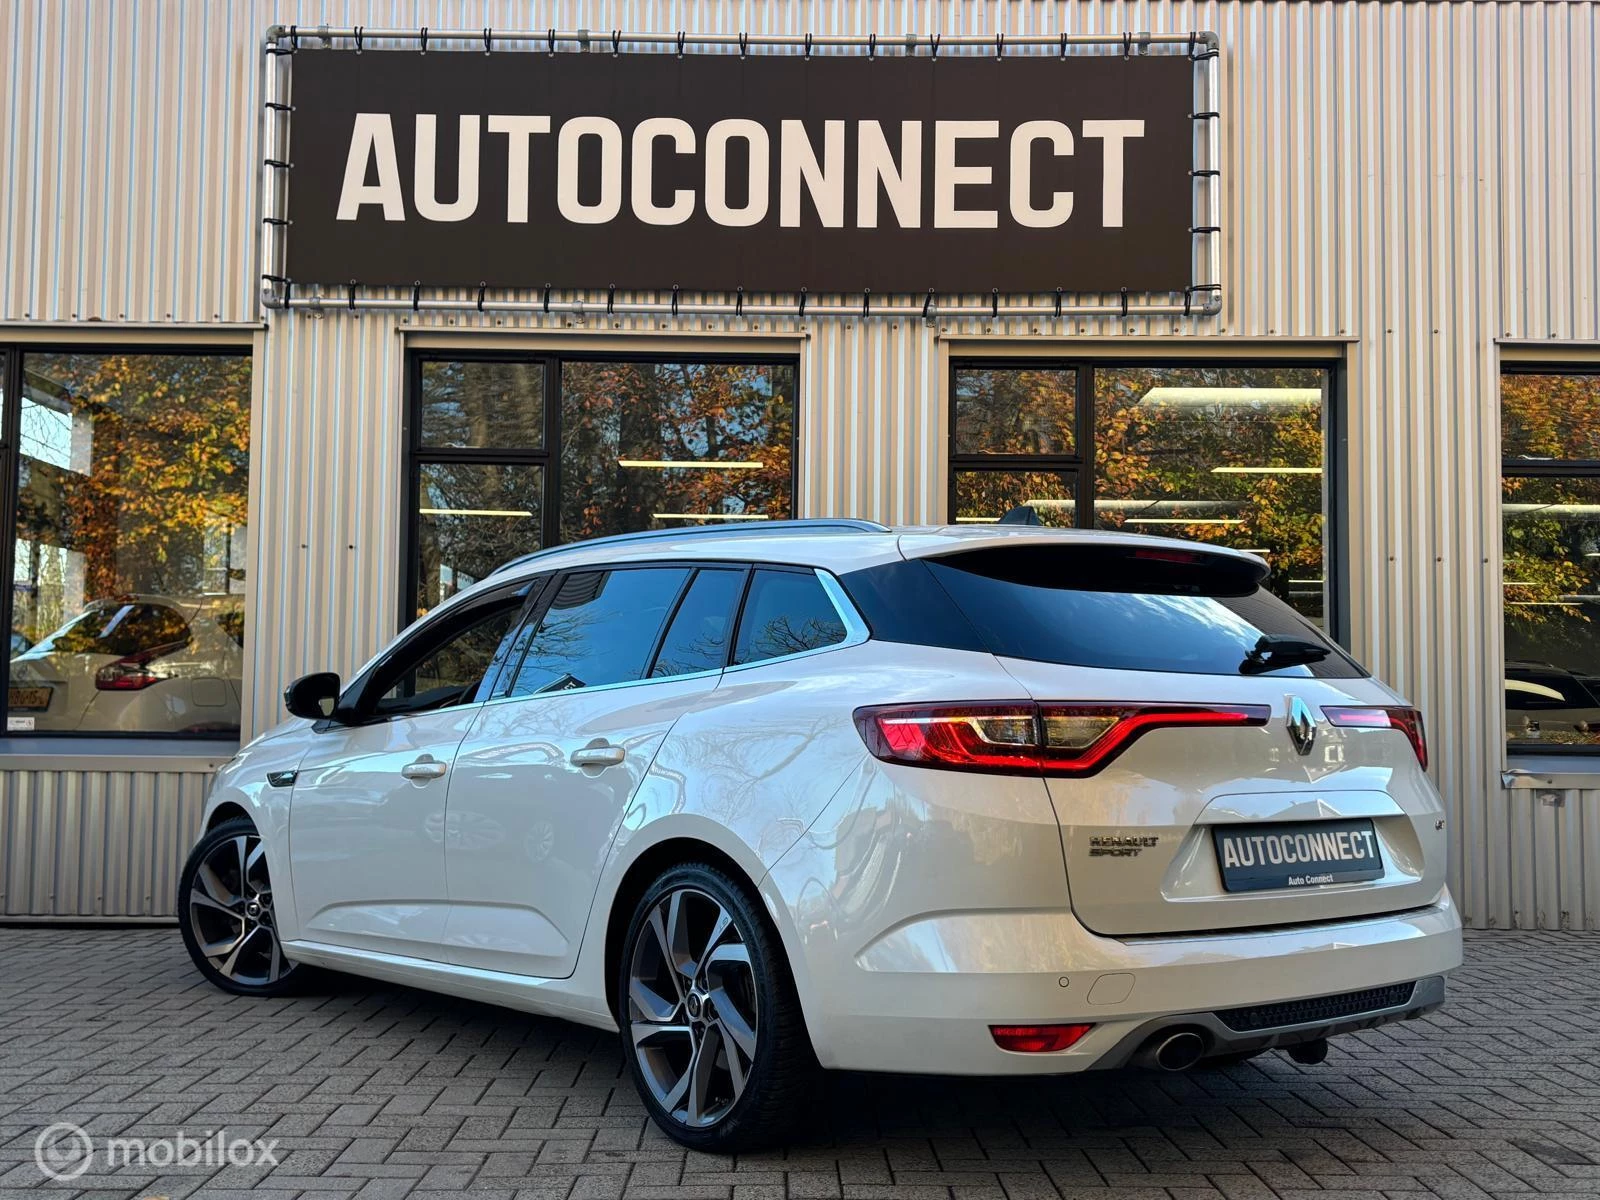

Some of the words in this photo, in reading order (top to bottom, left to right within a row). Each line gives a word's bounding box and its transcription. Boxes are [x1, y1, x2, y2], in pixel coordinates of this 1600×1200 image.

[335, 112, 1145, 229] AUTOCONNECT
[1090, 836, 1159, 847] RENAULT
[1089, 848, 1142, 857] SPORT
[1223, 830, 1374, 868] AUTOCONNECT
[1288, 876, 1304, 886] Auto
[1305, 873, 1334, 885] Connect
